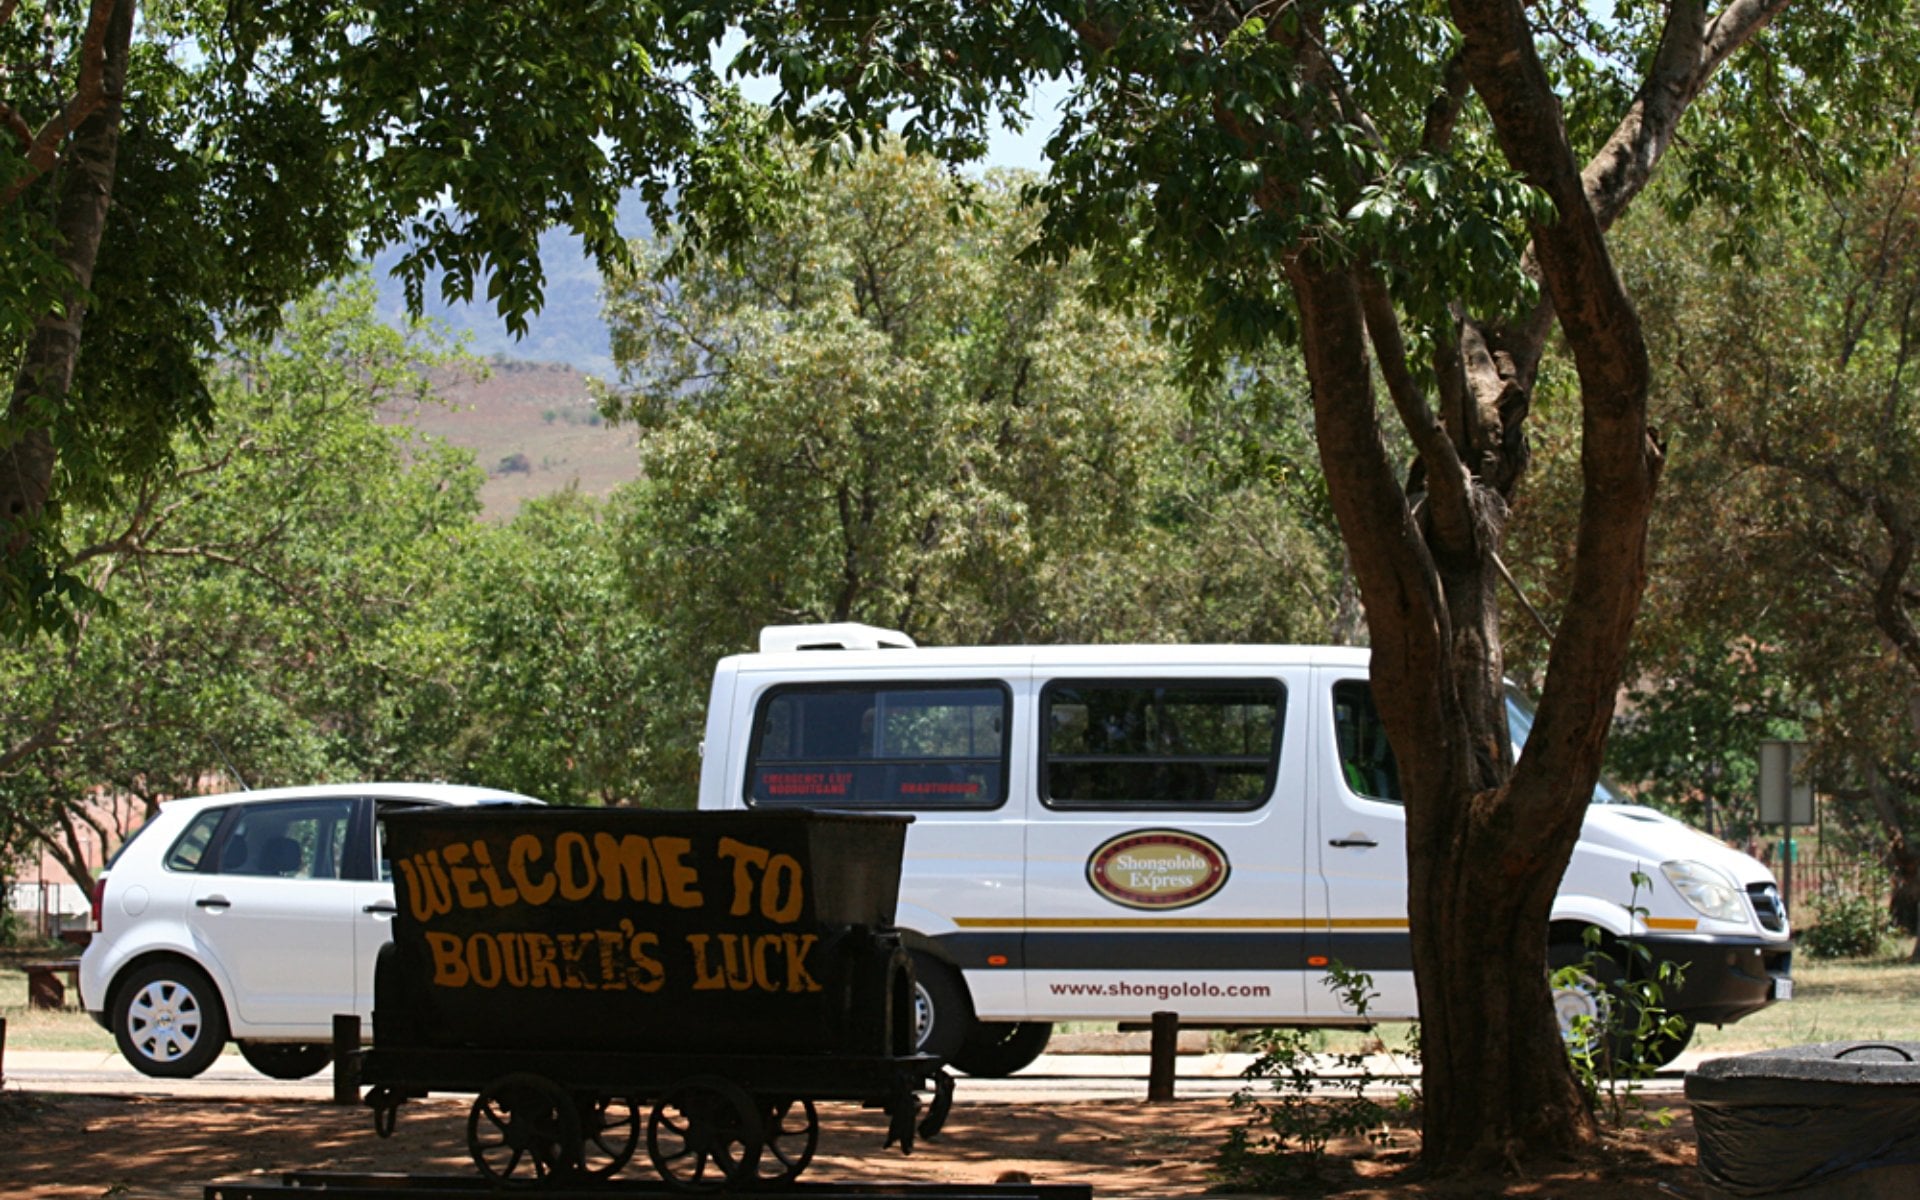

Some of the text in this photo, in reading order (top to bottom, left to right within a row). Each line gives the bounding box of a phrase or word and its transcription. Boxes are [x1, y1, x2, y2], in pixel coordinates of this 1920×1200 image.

[1116, 854, 1206, 872] Shongololo
[401, 831, 802, 924] WELCOME TO
[1129, 872, 1193, 890] Express
[686, 933, 822, 993] LUCK
[1050, 982, 1271, 1000] www.shongololo.com
